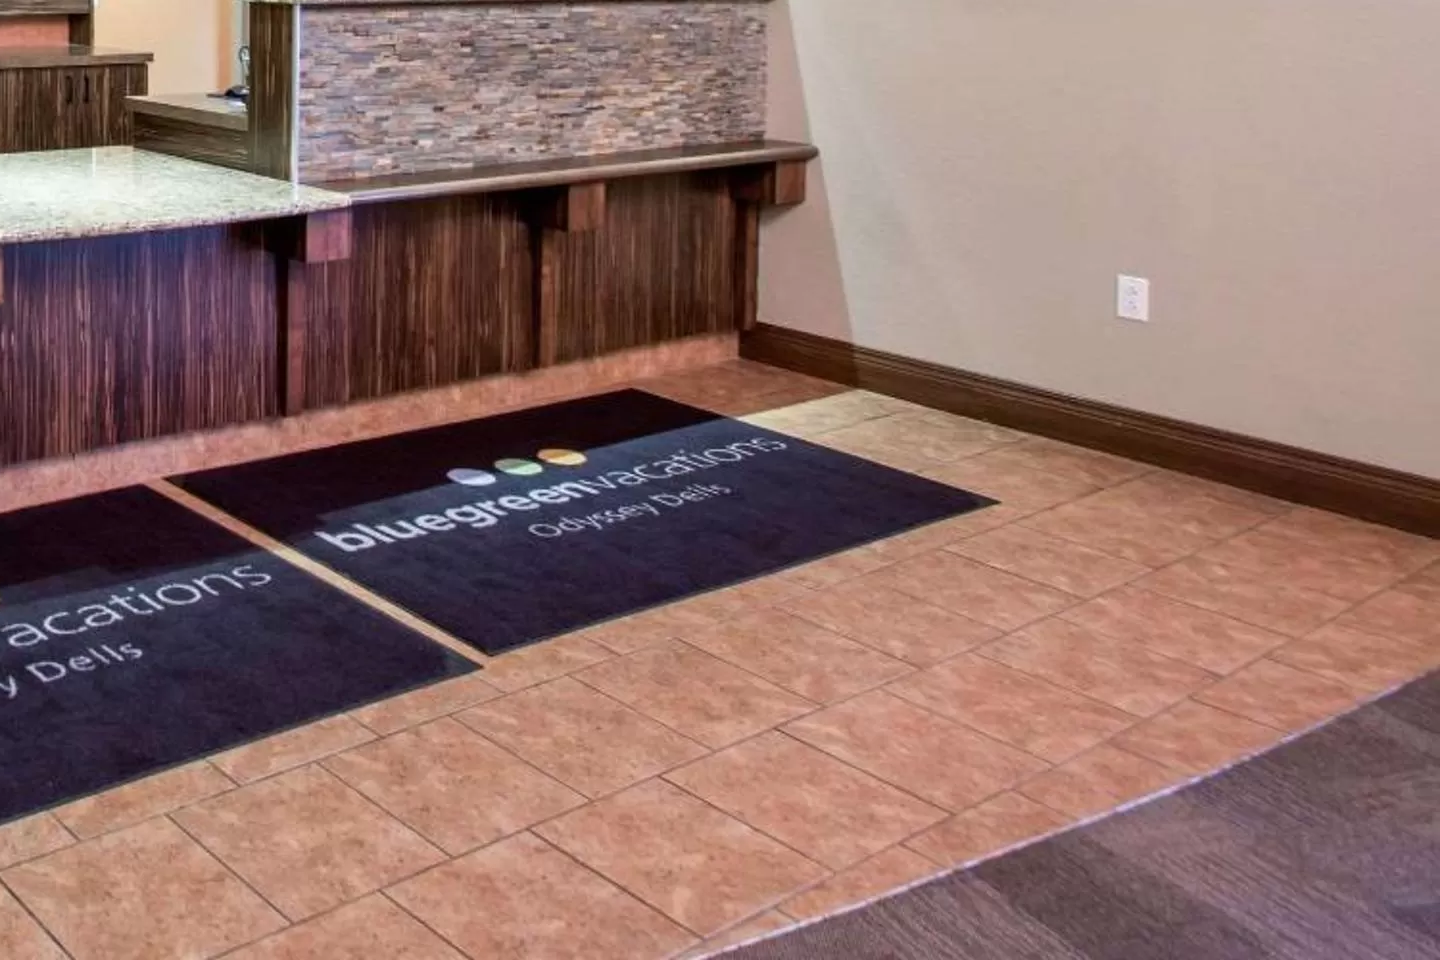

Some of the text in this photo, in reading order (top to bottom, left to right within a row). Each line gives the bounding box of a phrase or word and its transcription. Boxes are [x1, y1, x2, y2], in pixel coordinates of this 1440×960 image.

[527, 483, 732, 538] Odyssey Dells
[25, 640, 144, 683] Dells
